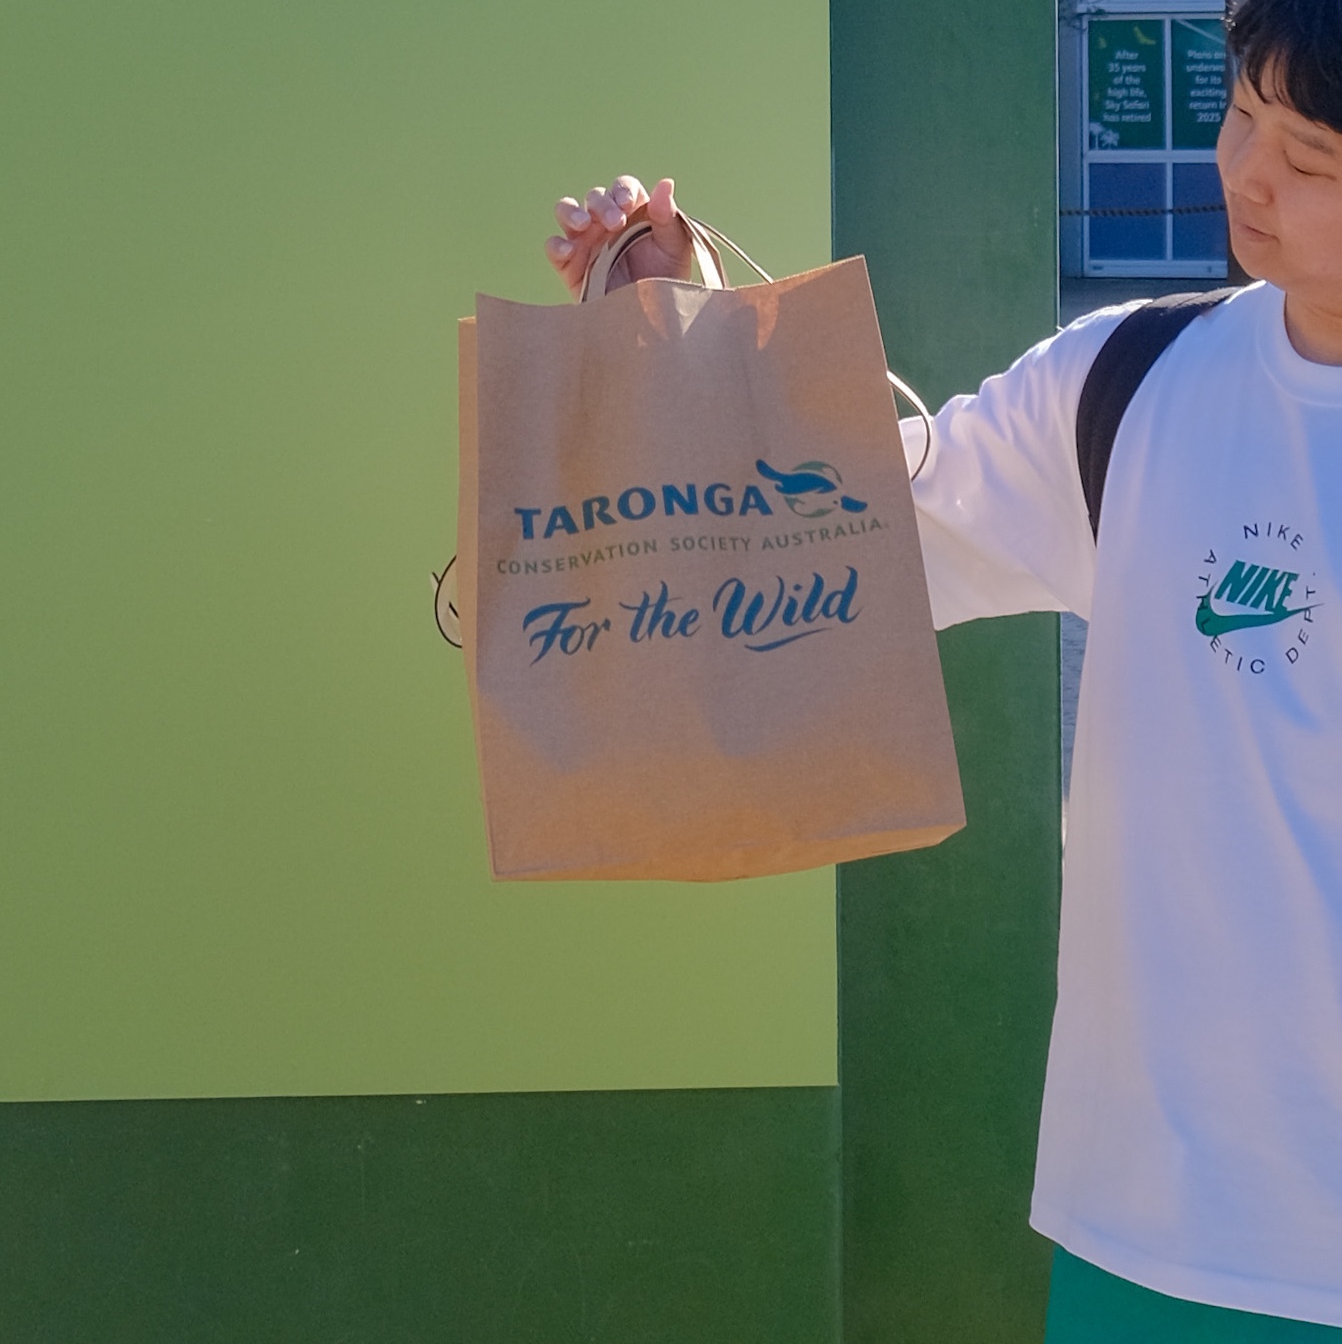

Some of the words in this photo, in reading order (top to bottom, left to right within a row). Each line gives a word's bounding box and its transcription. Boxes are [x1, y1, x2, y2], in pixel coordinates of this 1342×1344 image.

[1115, 50, 1139, 60] After
[1122, 64, 1146, 74] years
[1186, 63, 1226, 72] underwa
[1113, 75, 1123, 85] of
[1125, 75, 1140, 85] the
[1195, 75, 1208, 84] for
[1107, 88, 1128, 99] high
[1105, 100, 1120, 112] Sky
[1122, 113, 1151, 122] retired
[513, 482, 774, 541] TARONGA
[1243, 521, 1304, 551] NIKE
[496, 538, 659, 575] CONSERVATION
[670, 535, 752, 553] SOCIETY
[761, 516, 884, 551] AUSTRALIA
[1214, 559, 1300, 614] NIKE
[522, 597, 611, 667] For
[619, 580, 700, 644] the
[712, 565, 864, 642] Wild
